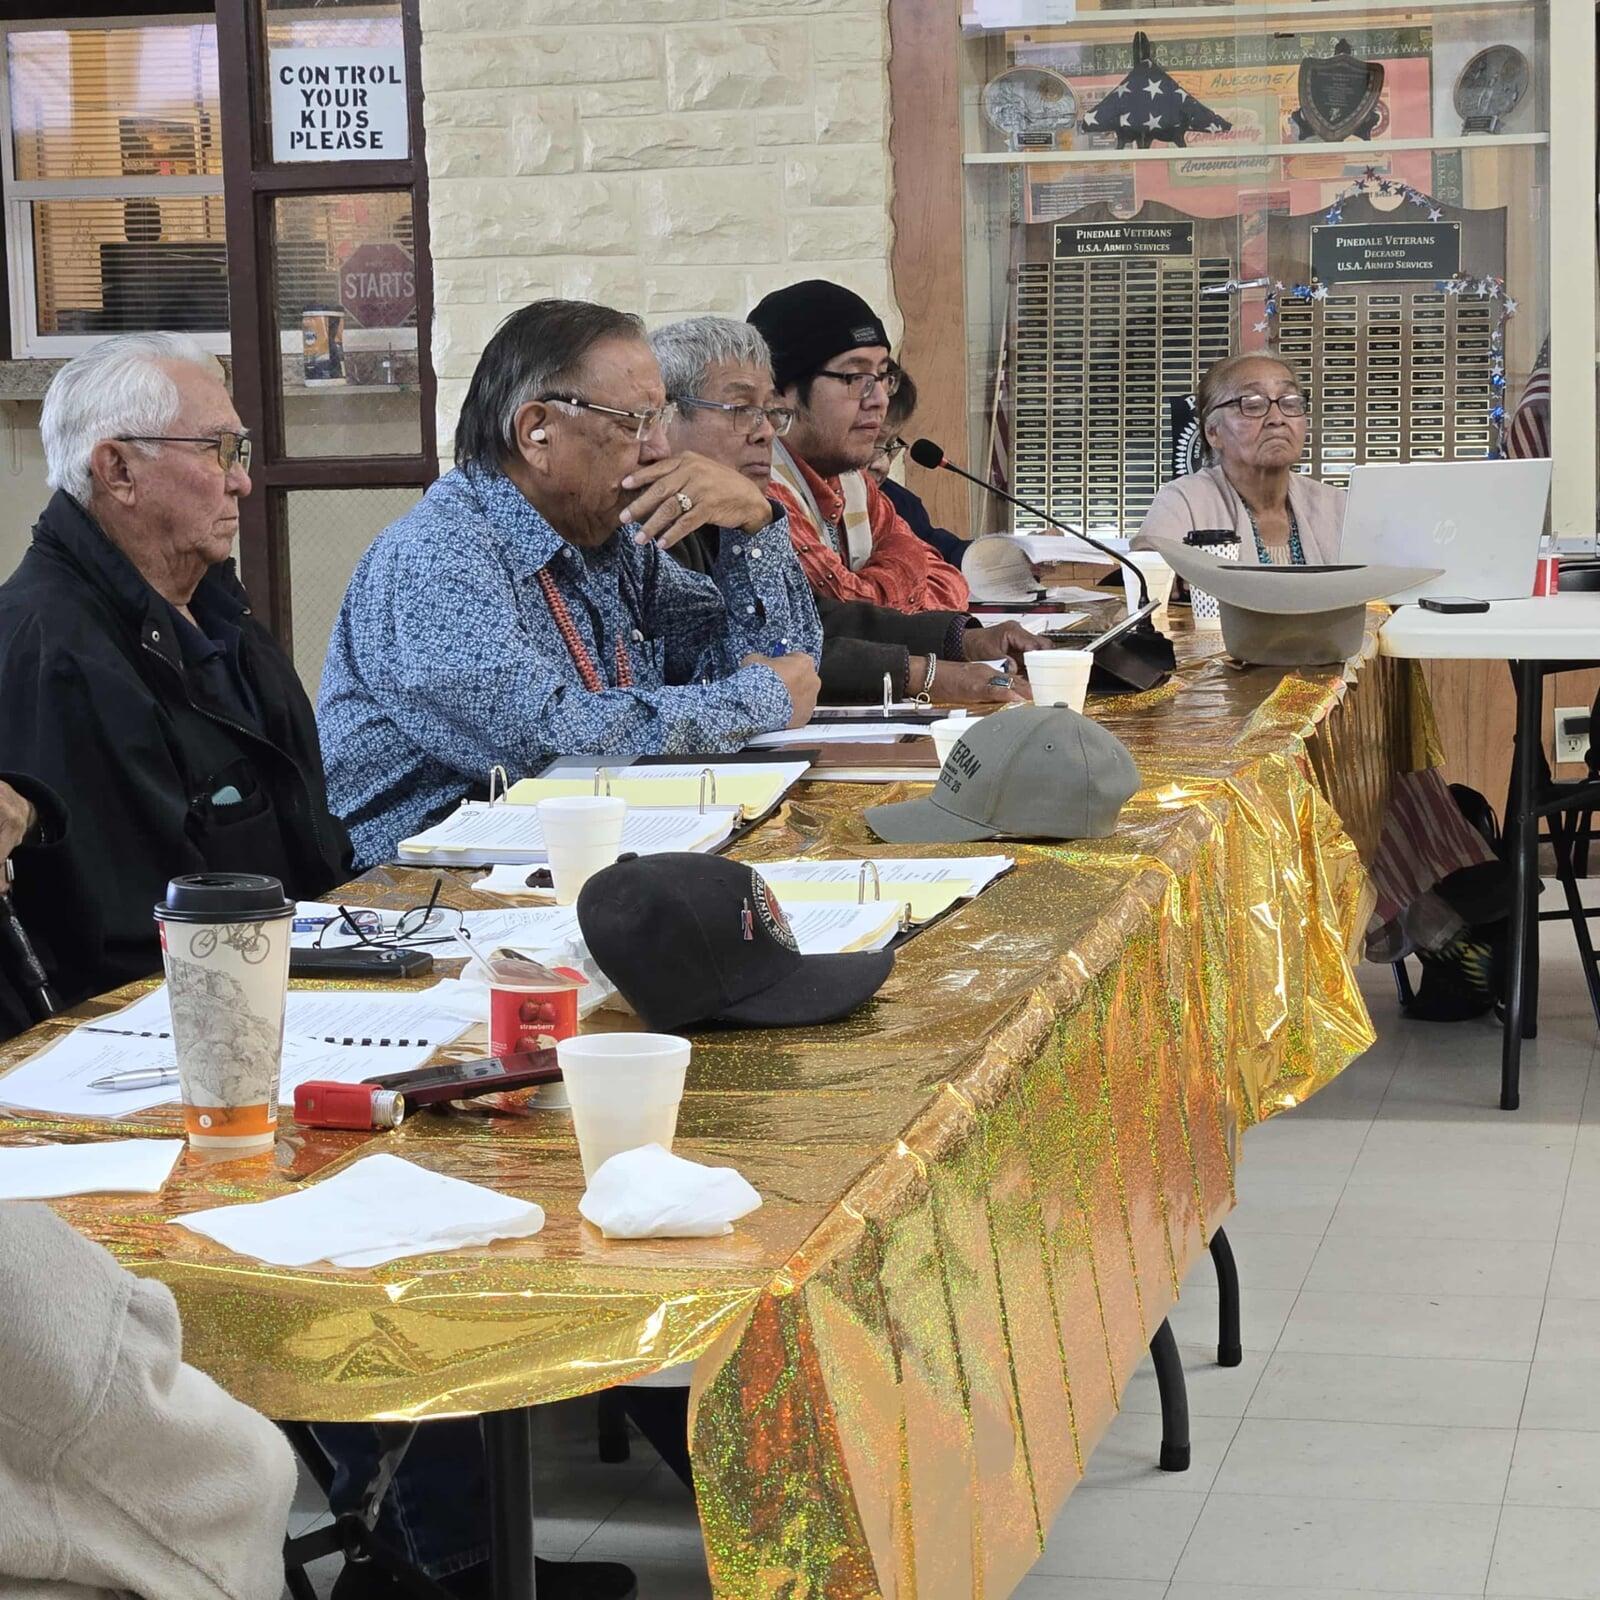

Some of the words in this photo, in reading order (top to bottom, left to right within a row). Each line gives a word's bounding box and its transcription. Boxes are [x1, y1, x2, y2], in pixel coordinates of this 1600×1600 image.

[280, 65, 402, 85] CONTROL
[301, 88, 368, 108] YOUR
[301, 110, 369, 128] KIDS
[290, 131, 383, 149] PLEASE
[1076, 229, 1121, 239] PINEDALE
[1124, 227, 1172, 238] VETERANS
[1336, 237, 1383, 247] PINEDALE
[1385, 235, 1435, 246] VETERANS
[1077, 244, 1102, 253] U.S.A.
[1103, 243, 1132, 252] ARMED
[1133, 242, 1170, 251] SERVICES
[1364, 249, 1405, 258] DECEASED
[1337, 261, 1362, 271] U.S.A.
[1364, 261, 1394, 270] ARMED
[1395, 260, 1433, 269] SERVICES
[344, 271, 415, 299] STARTS
[519, 1023, 556, 1031] strawberry
